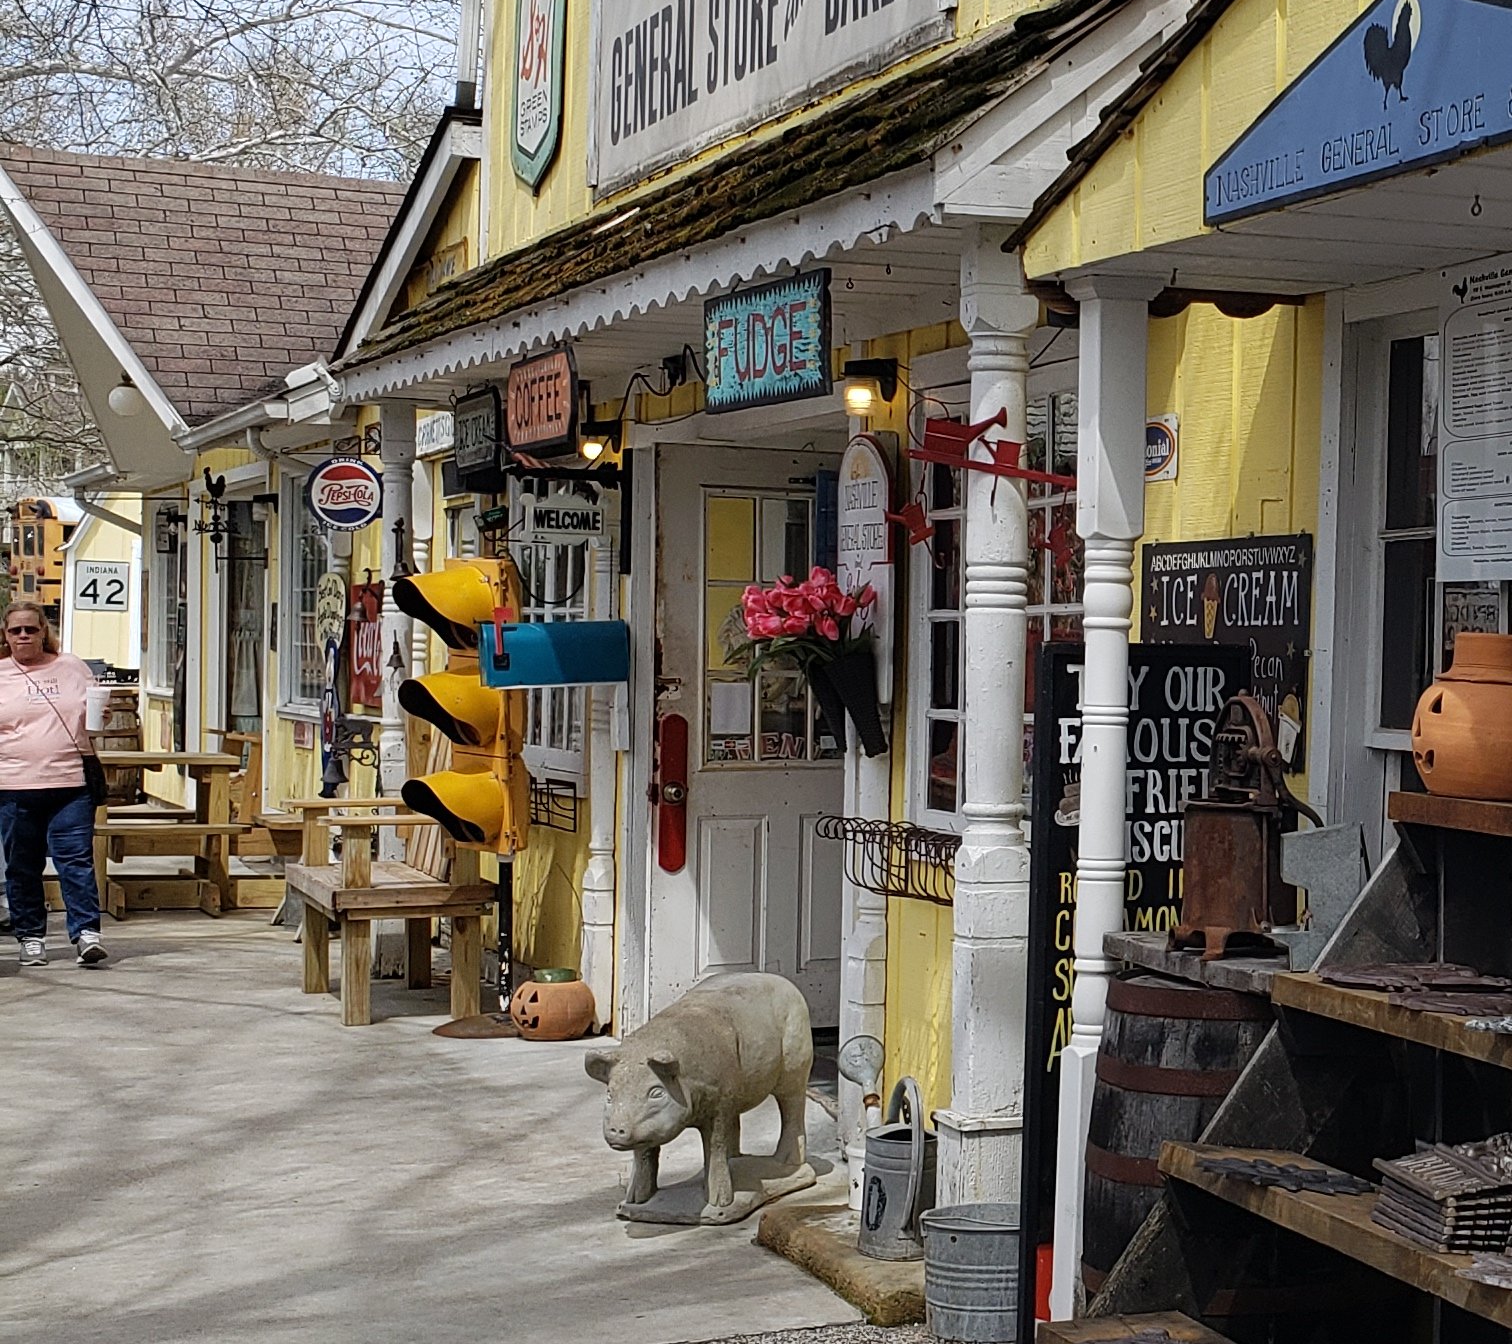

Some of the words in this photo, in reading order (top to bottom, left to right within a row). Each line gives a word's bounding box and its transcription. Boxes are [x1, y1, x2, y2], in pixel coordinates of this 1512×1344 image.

[520, 90, 548, 117] GREEN
[519, 112, 548, 137] STAMPS
[1215, 148, 1305, 207] NASHVILLE
[1320, 122, 1400, 174] GENERAL
[1418, 94, 1485, 146] STORE
[716, 300, 808, 387] FUDGE
[514, 371, 562, 430] COFFEE
[533, 508, 601, 532] WELCOME
[86, 566, 119, 575] INDIANA
[1150, 545, 1297, 573] ABCDEFGHIJKLMNOPQRSTUVWXYZ
[79, 578, 125, 605] 42
[1160, 573, 1199, 627] ICE
[1223, 569, 1300, 628] CREAM
[1066, 663, 1150, 712] TY
[1164, 665, 1227, 712] OUR
[1057, 717, 1216, 764] FOUS
